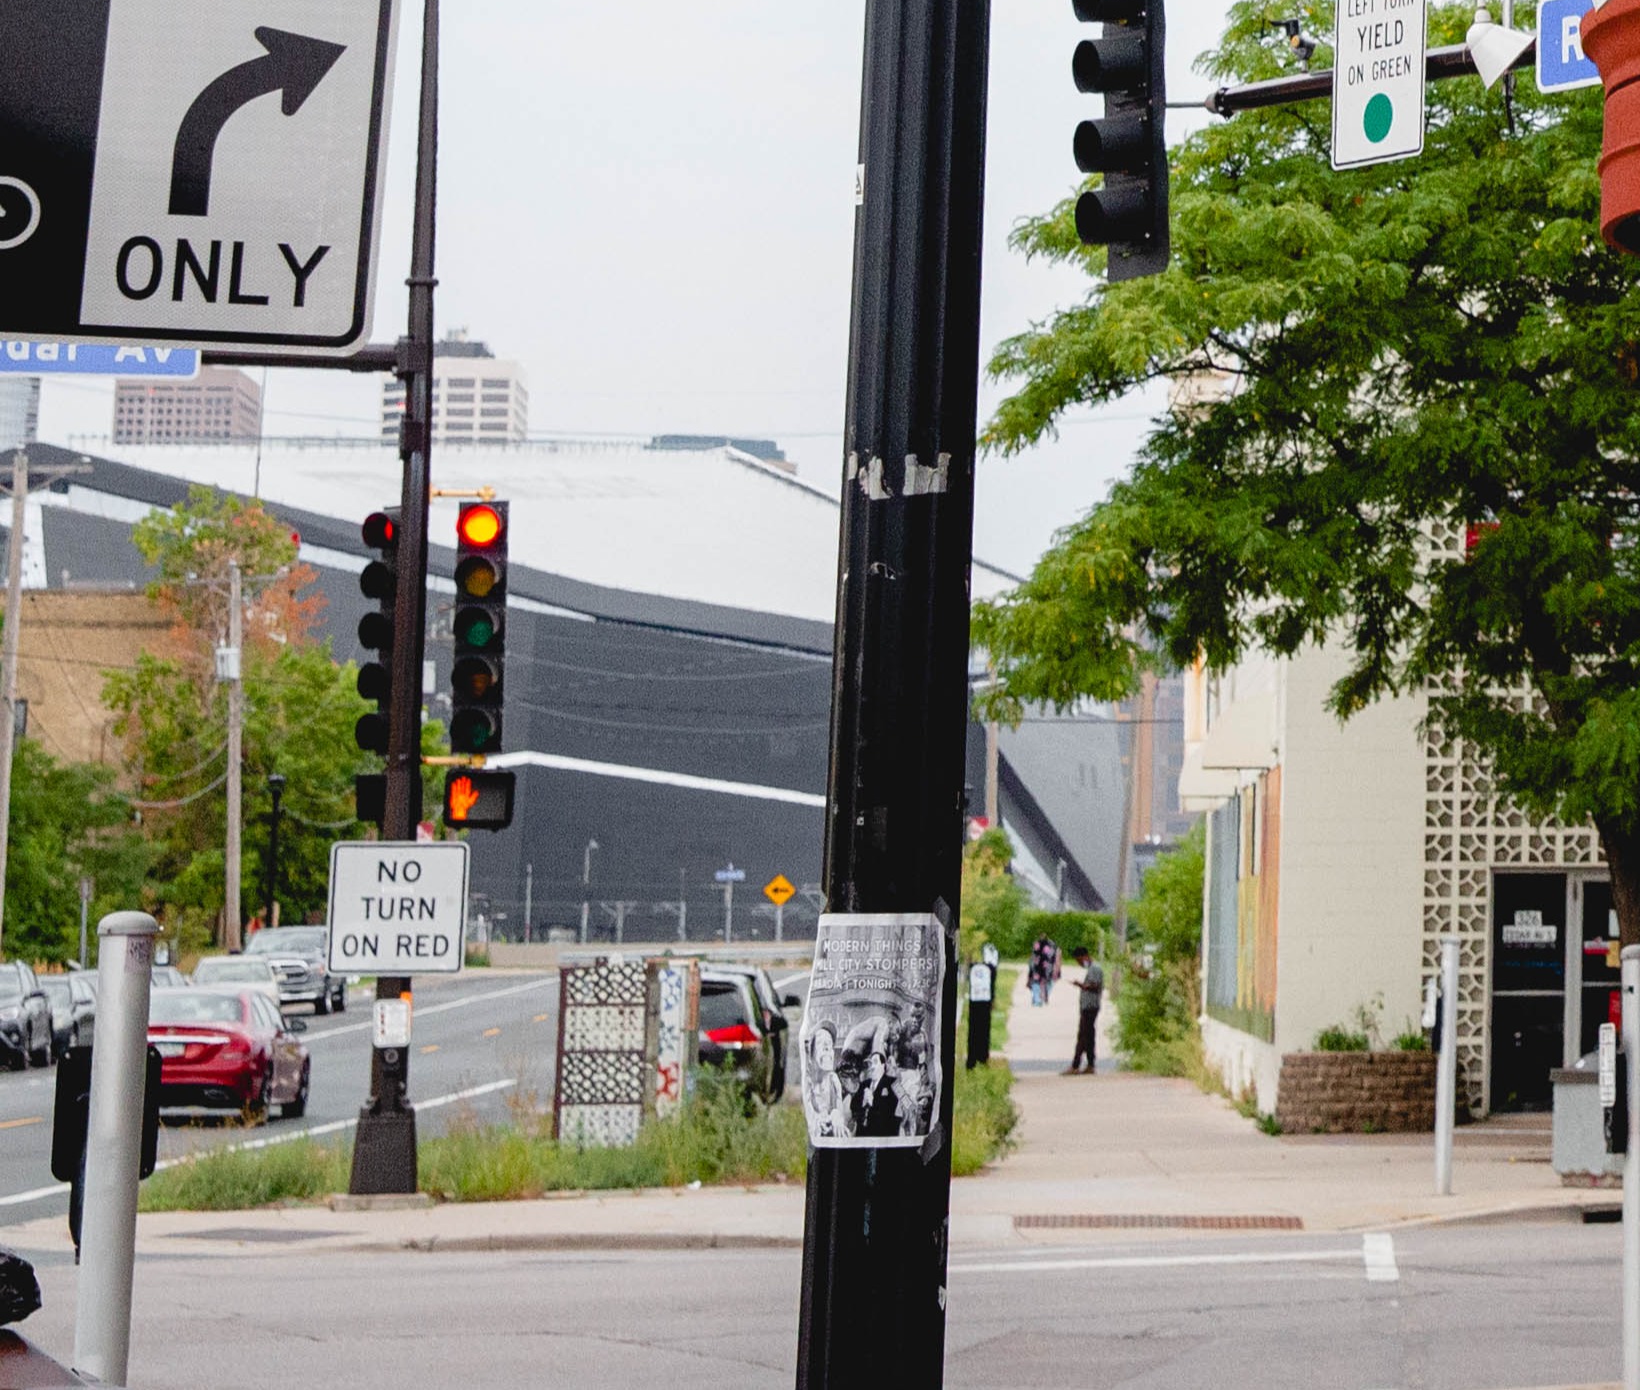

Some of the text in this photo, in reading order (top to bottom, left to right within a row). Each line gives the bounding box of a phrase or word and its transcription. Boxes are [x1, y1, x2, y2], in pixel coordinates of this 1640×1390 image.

[1357, 19, 1404, 53] YIELD
[1348, 55, 1412, 86] ON GREEN
[115, 235, 332, 308] ONLY
[378, 860, 422, 883] NO
[361, 896, 436, 921] TURN
[342, 934, 449, 957] ON RED
[823, 939, 921, 953] MODERN THINGS
[838, 959, 860, 971] CITY
[866, 958, 933, 971] STOMPERS
